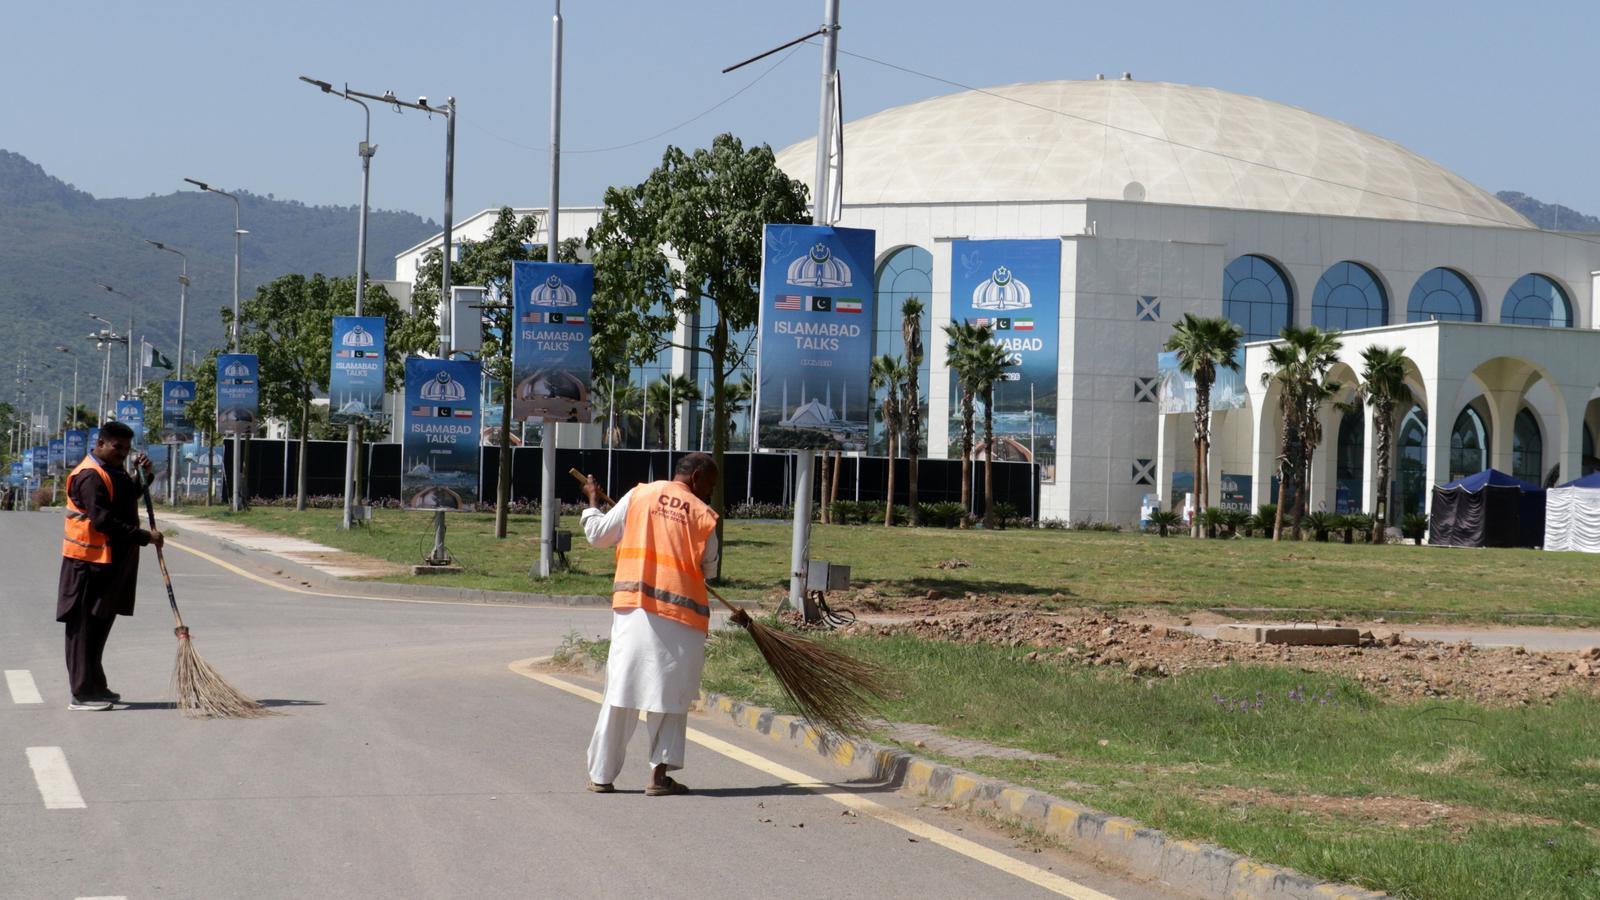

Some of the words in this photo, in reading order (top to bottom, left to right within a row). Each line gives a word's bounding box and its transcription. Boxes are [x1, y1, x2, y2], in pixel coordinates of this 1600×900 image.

[774, 321, 861, 337] ISLAMABAD
[522, 330, 584, 342] ISLAMABAD
[537, 341, 569, 351] TALKS
[794, 336, 839, 351] TALKS
[988, 338, 1043, 351] MABAD
[411, 423, 472, 434] ISLAMABAD
[426, 434, 457, 444] TALKS
[658, 494, 690, 514] CDA
[1221, 502, 1238, 510] BAD
